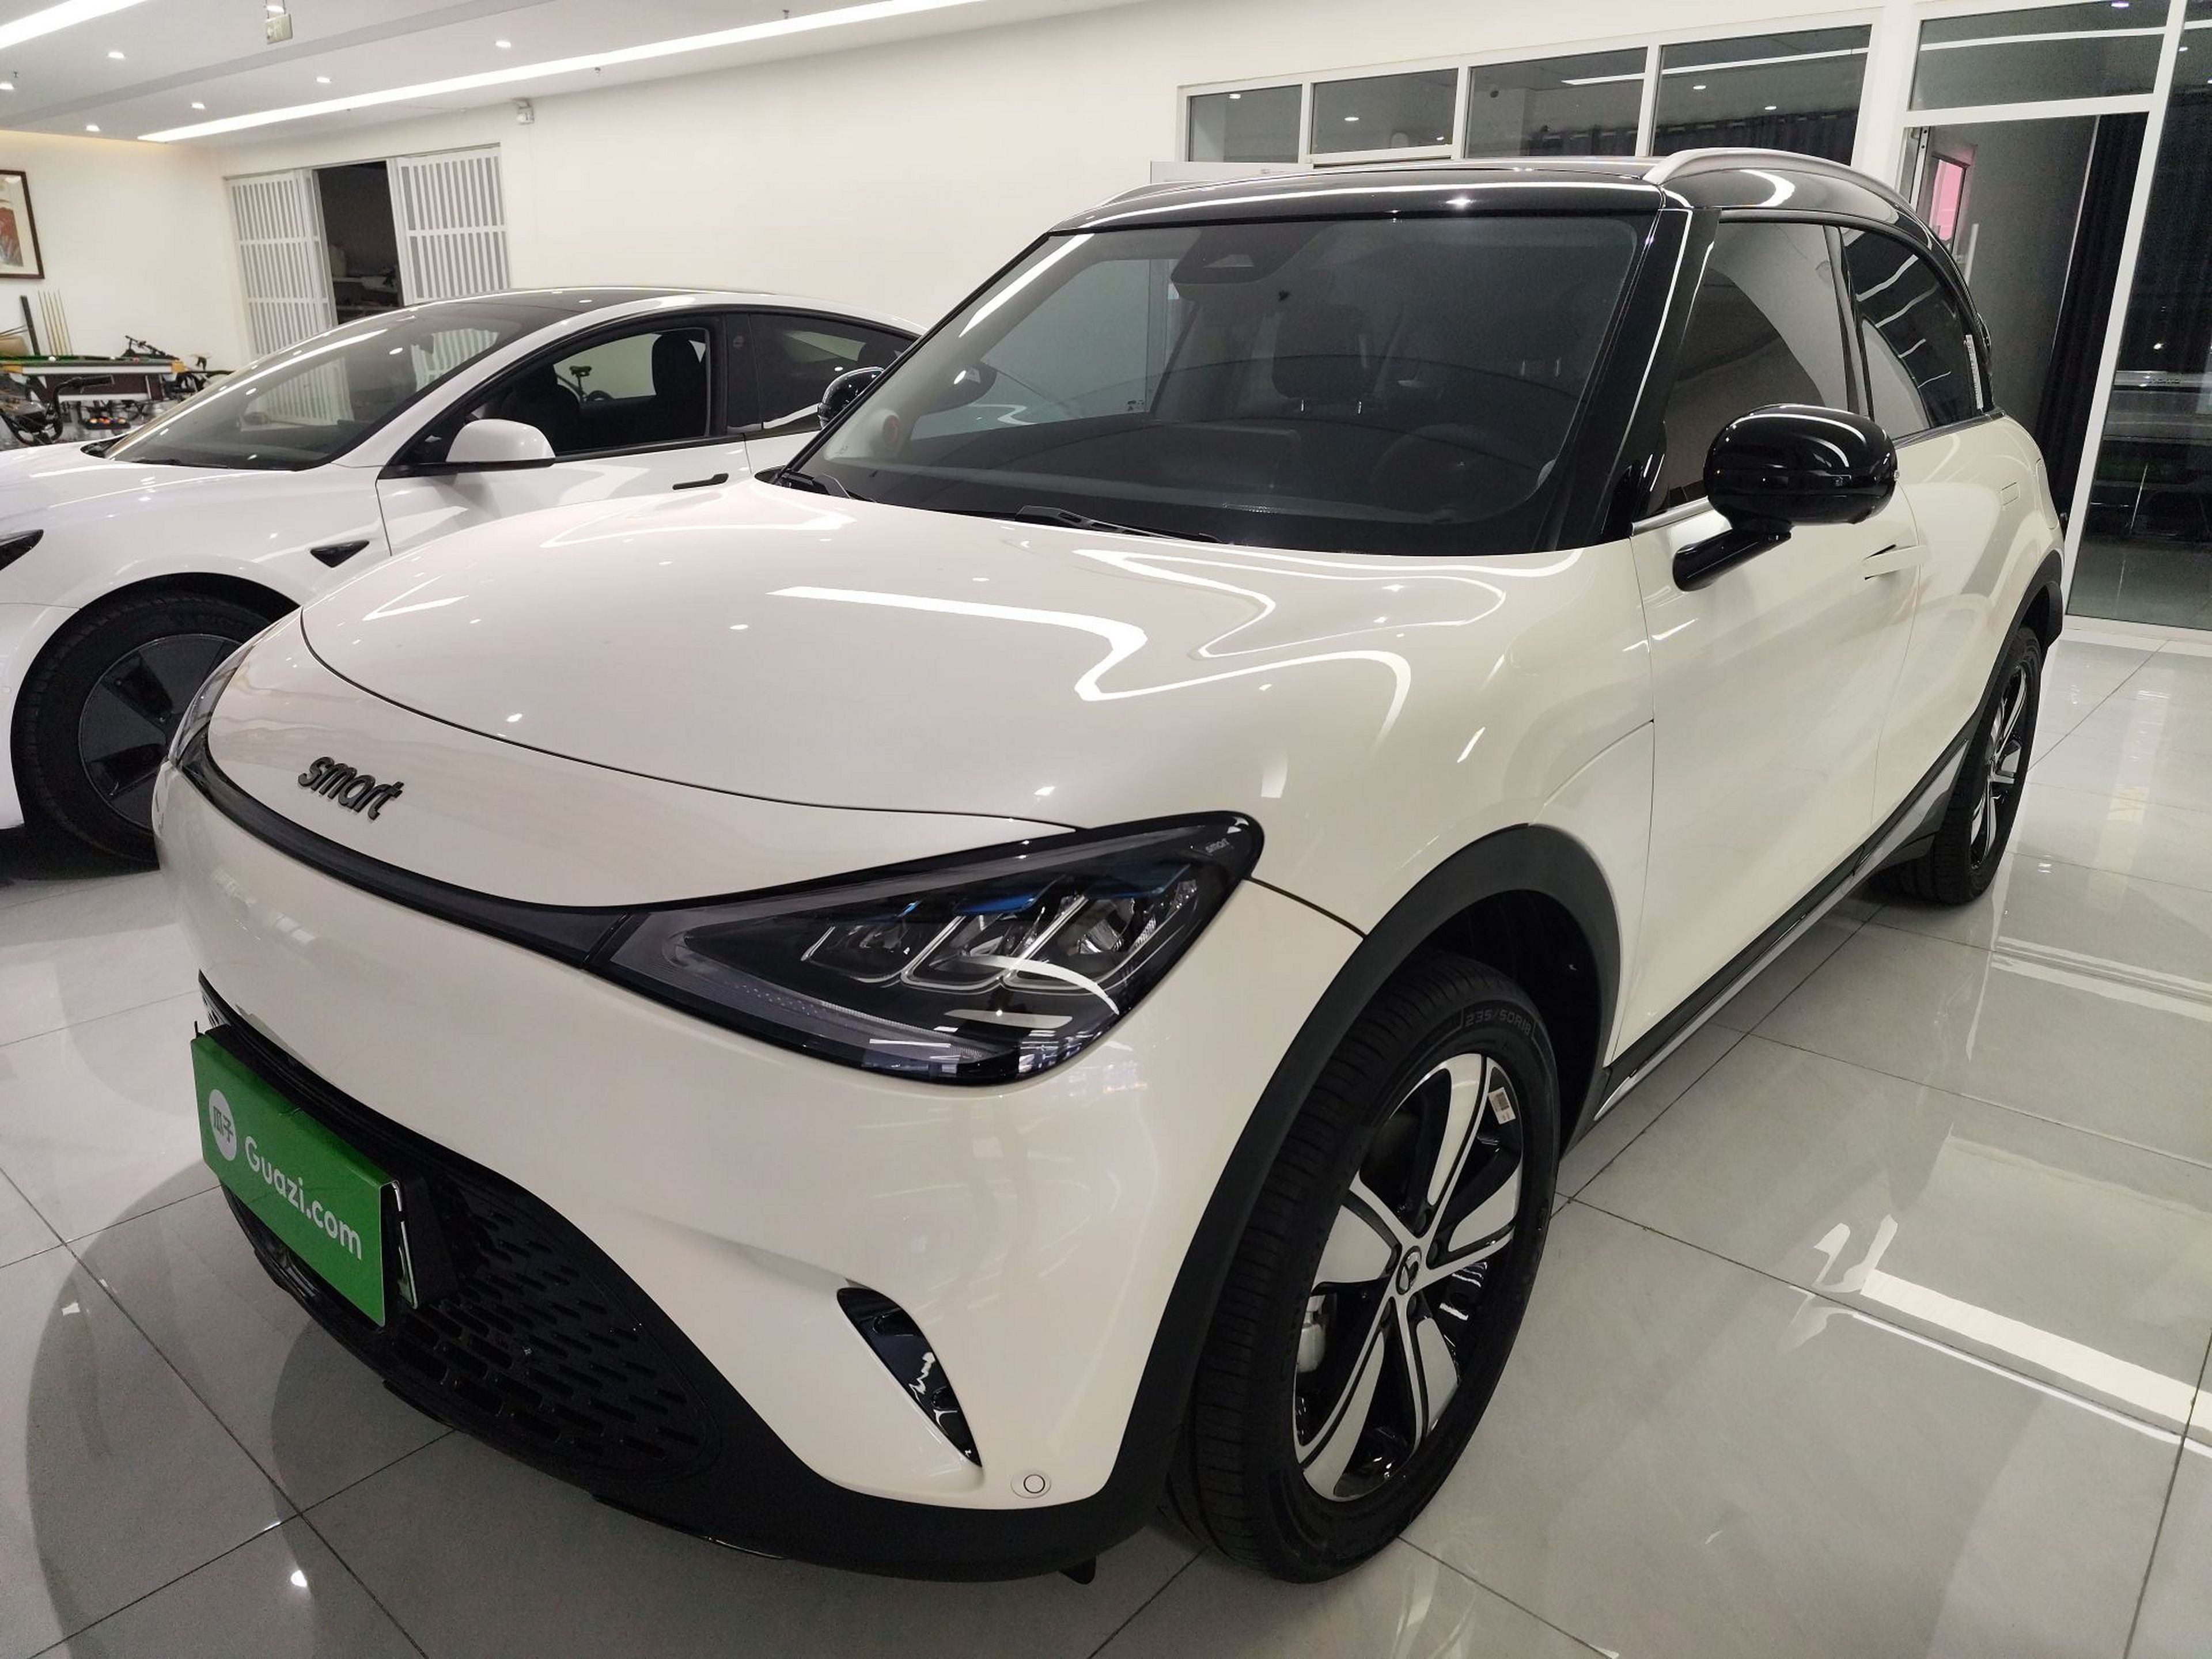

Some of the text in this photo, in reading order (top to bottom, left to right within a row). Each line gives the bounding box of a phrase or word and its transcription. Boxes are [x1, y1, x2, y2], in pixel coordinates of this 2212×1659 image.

[298, 756, 404, 821] smart
[1465, 1009, 1532, 1035] 235/50R18
[213, 1105, 234, 1143] 瓜子
[244, 1135, 362, 1261] Guazi.com
